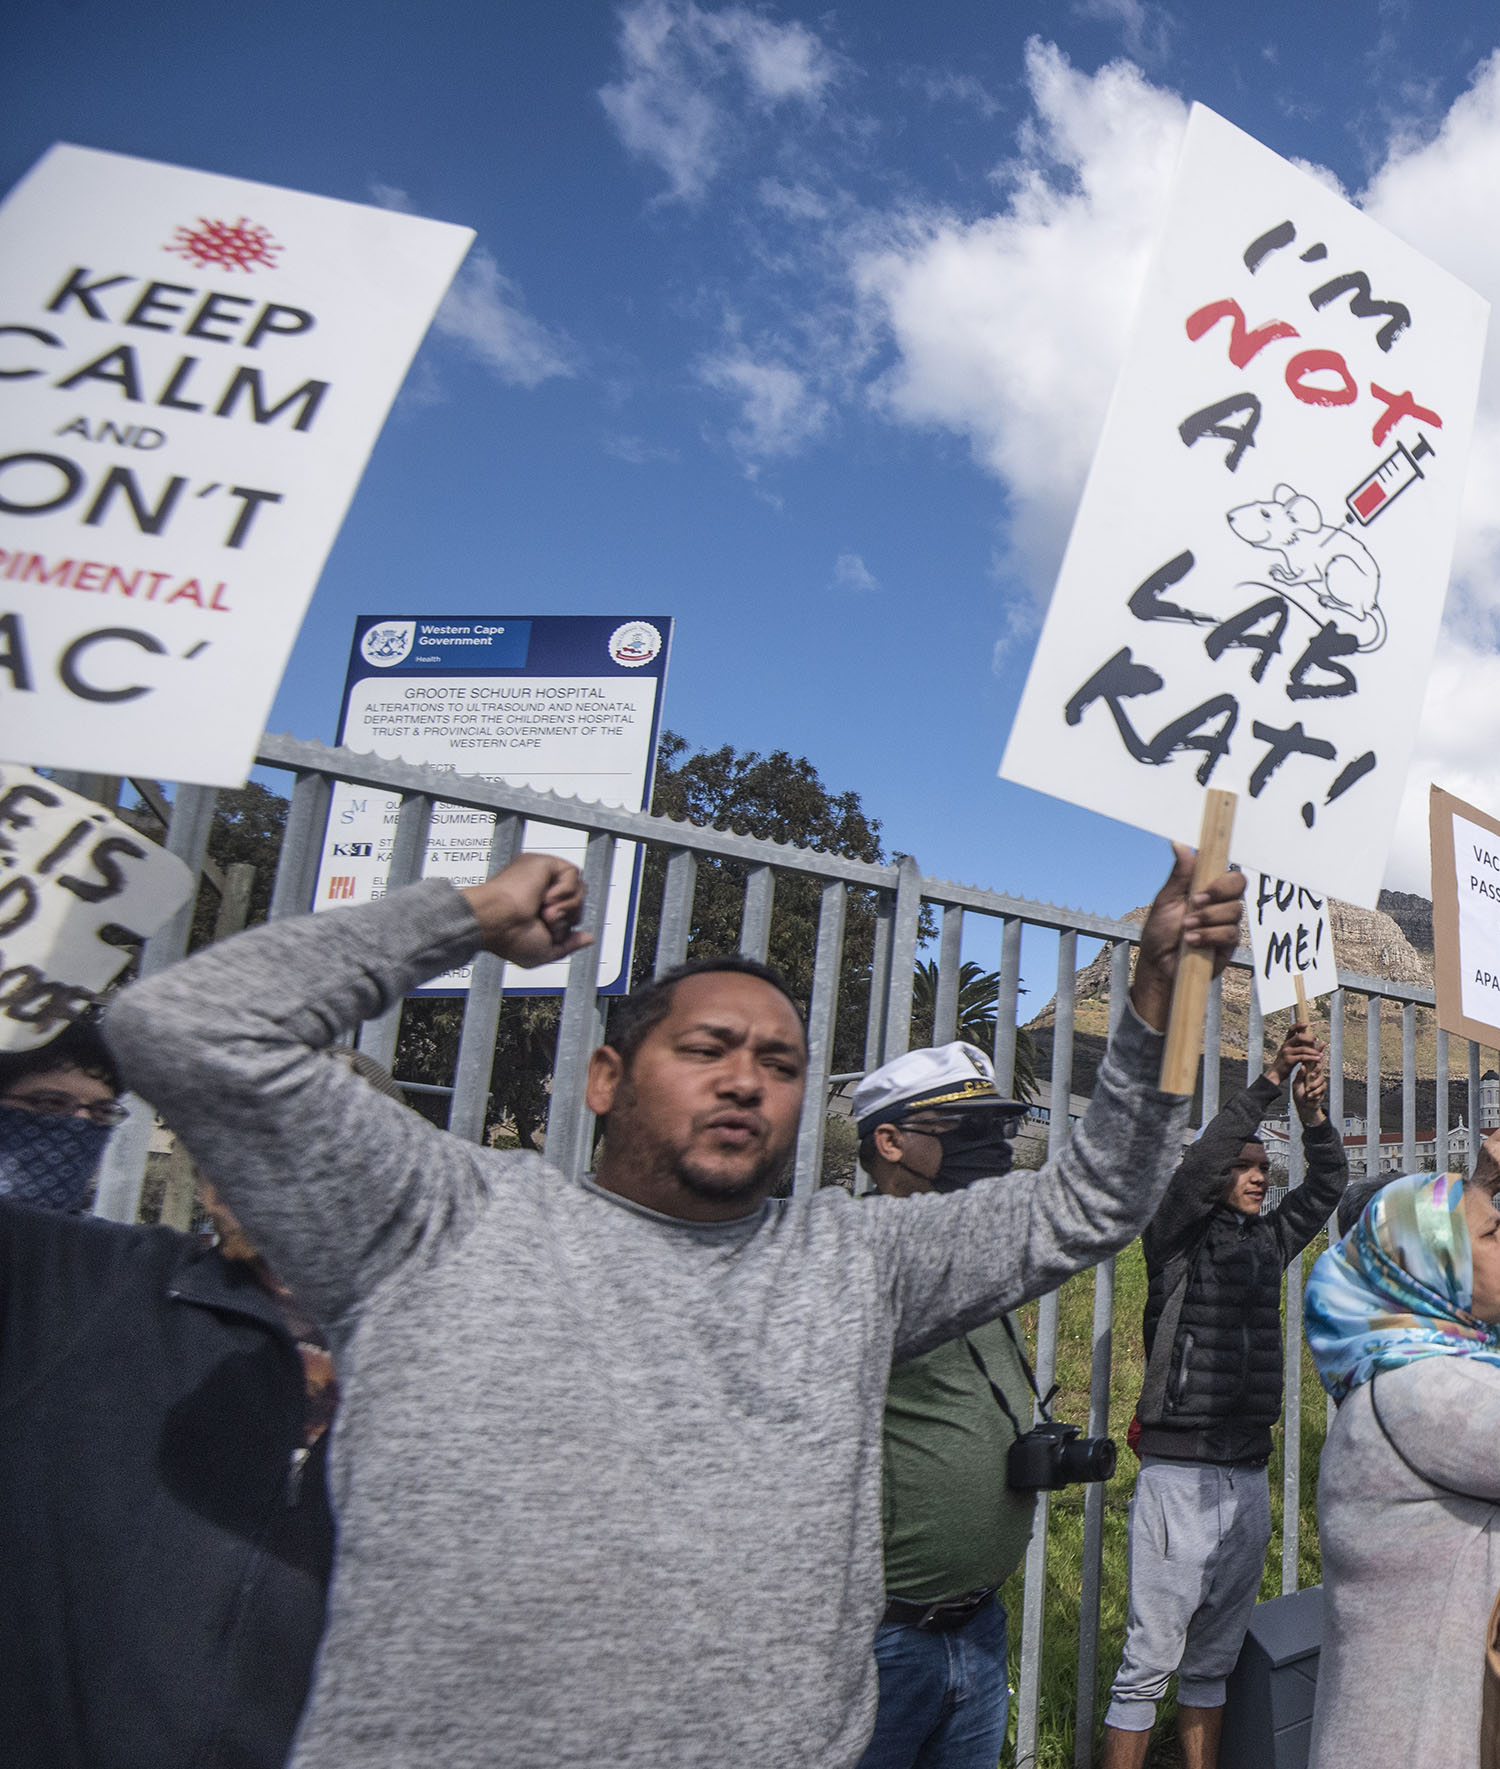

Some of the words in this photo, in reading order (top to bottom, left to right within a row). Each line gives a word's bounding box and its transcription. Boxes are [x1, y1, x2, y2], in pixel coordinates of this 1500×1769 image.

[1242, 219, 1412, 353] I'M
[45, 266, 317, 350] KEEP
[0, 325, 332, 433] CALM
[1186, 297, 1443, 448] NOT
[57, 417, 168, 452] AND
[1178, 392, 1262, 473] A
[0, 452, 287, 550] ON'T
[0, 550, 232, 613] IMENTAL
[420, 624, 471, 635] Western
[473, 624, 505, 637] Cape
[1127, 549, 1359, 701] LAB
[418, 636, 494, 646] Government
[415, 655, 442, 663] Health
[404, 687, 467, 699] GROOTE
[469, 687, 532, 699] SCHUUR
[534, 687, 606, 699] HOSPITAL
[363, 714, 450, 724] DEPARTMENTS
[453, 714, 478, 724] FOR
[481, 714, 503, 724] THE
[506, 714, 575, 724] CHILDREN'S
[577, 714, 635, 724] HOSPITAL
[364, 702, 445, 712] ALTERATIONS
[448, 702, 464, 712] TO
[466, 702, 546, 712] ULTRASOUND
[548, 702, 573, 712] AND
[575, 702, 637, 712] NEONATAL
[372, 726, 411, 736] TRUST
[412, 726, 420, 736] &
[423, 726, 493, 736] PROVINCIAL
[496, 726, 578, 736] GOVERNMENT
[580, 726, 598, 736] OF
[600, 726, 623, 736] THE
[449, 738, 508, 748] WESTERN
[510, 738, 542, 748] CAPE
[1065, 646, 1377, 830] RAT!
[430, 813, 497, 824] SUMMERS
[450, 838, 494, 847] ENGINEE
[431, 852, 439, 862] &
[444, 852, 492, 862] TEMPLE
[1264, 918, 1323, 980] ME!
